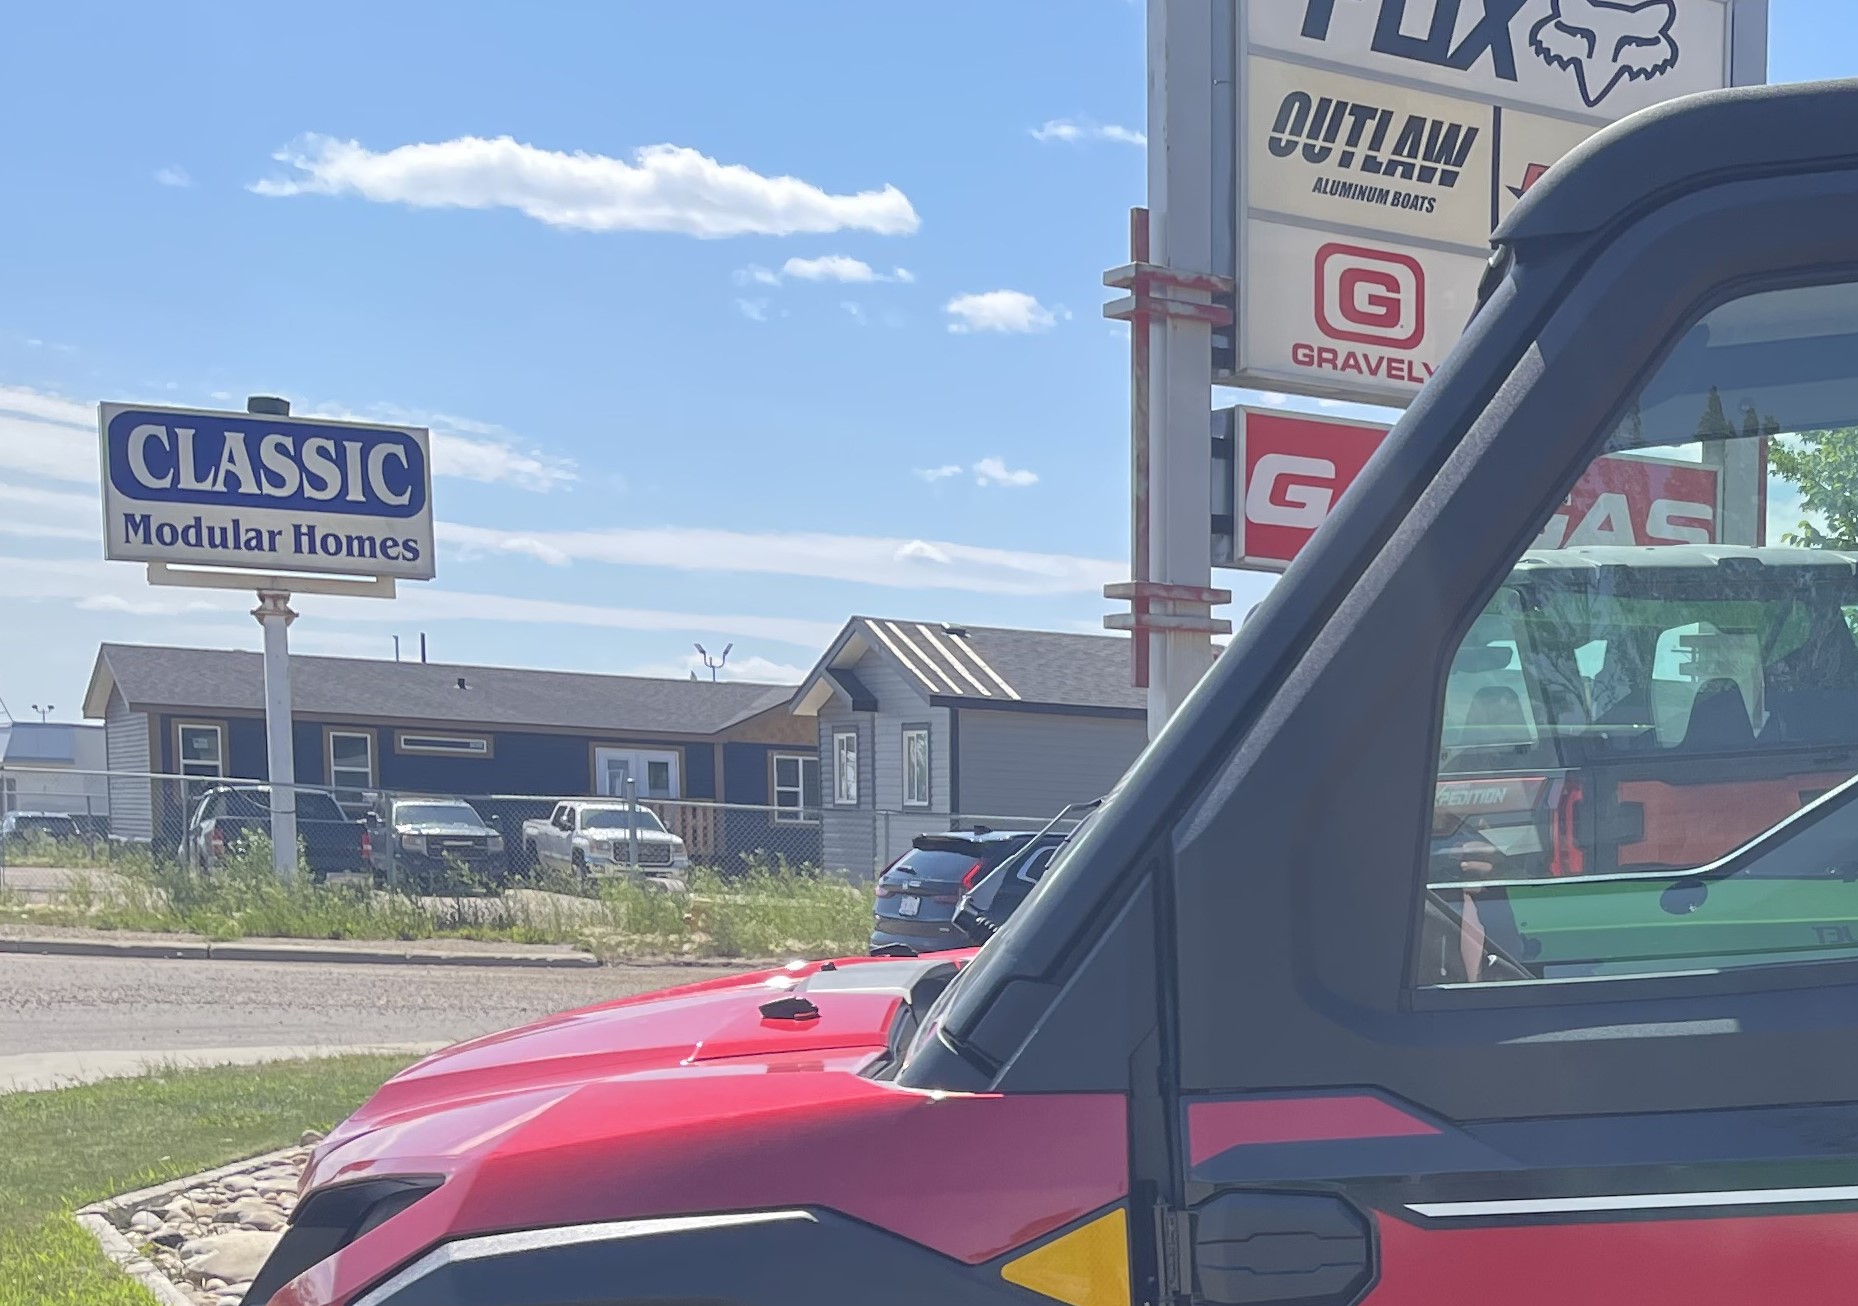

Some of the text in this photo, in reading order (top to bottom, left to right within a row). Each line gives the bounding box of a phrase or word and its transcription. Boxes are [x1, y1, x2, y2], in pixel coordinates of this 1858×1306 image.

[1268, 91, 1480, 188] OUTLAW
[1312, 177, 1437, 214] ALUMINUM BOATS
[1291, 342, 1440, 384] GRAVELY
[127, 423, 412, 506] CLASSIC
[122, 513, 421, 562] Modular Homes
